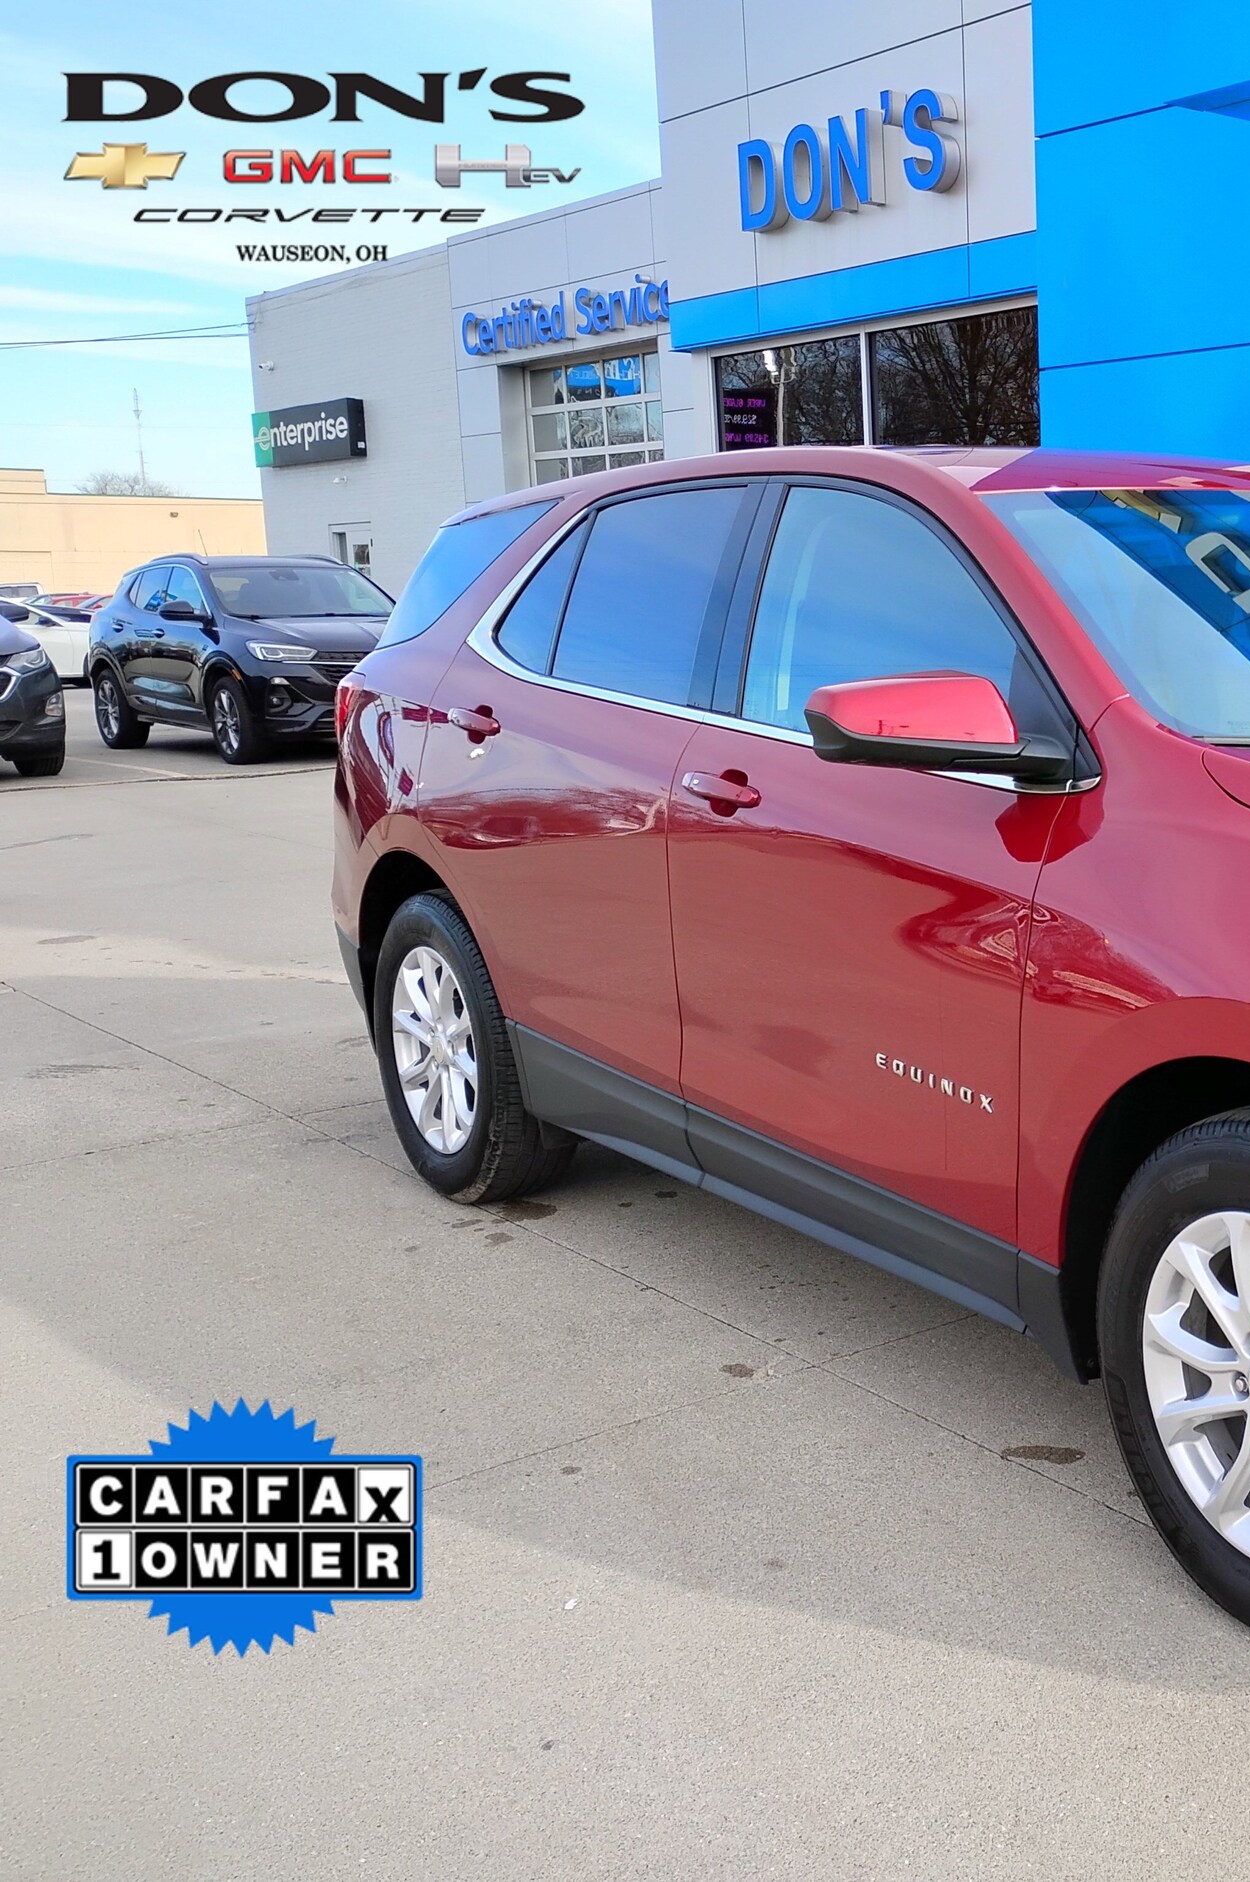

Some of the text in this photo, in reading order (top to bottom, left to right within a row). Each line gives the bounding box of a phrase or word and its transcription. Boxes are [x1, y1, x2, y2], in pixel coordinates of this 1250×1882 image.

[737, 89, 960, 232] DON'S
[462, 273, 669, 356] Certified Service
[255, 411, 349, 451] enterprise
[876, 1052, 994, 1113] EQUINOX
